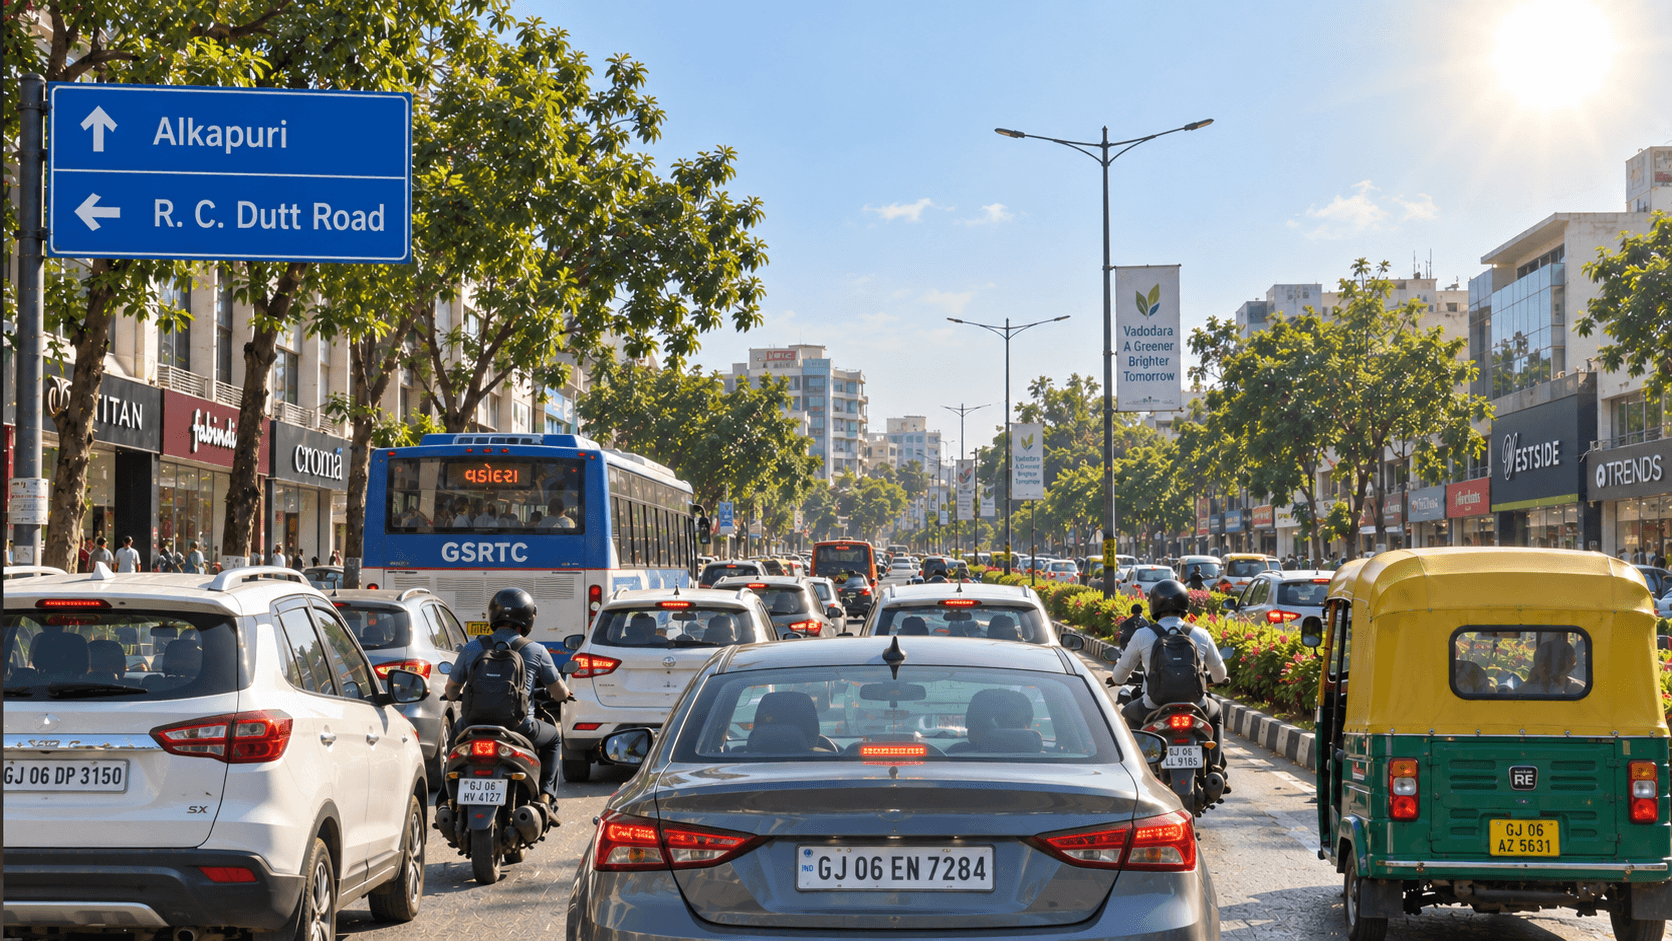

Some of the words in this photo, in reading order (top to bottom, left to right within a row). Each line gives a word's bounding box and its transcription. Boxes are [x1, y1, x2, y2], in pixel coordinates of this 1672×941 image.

[153, 116, 288, 155] Alkapuri
[154, 198, 183, 228] R.
[195, 199, 224, 228] C.
[237, 200, 302, 230] Dutt
[313, 202, 385, 232] Road
[1123, 324, 1174, 337] Vadodara
[1123, 341, 1132, 352] A
[1134, 340, 1175, 352] Greener
[1128, 355, 1170, 370] Brighter
[1123, 370, 1175, 382] Tomorrow
[192, 408, 238, 453] fabindi
[1501, 432, 1560, 481] WESTSIDE
[464, 462, 518, 483] વડોદરા
[1606, 454, 1663, 487] TRENDS
[441, 541, 529, 563] GSRTC
[4, 766, 25, 785] GJ
[29, 766, 50, 785] 06
[55, 767, 76, 785] DP
[80, 766, 123, 785] 3150
[1514, 774, 1534, 785] RE
[470, 781, 482, 790] GJ
[485, 782, 496, 790] 06
[464, 793, 476, 802] HV
[478, 793, 501, 802] 4127
[187, 805, 208, 814] SX
[1506, 823, 1523, 837] GJ
[1528, 823, 1544, 837] 06
[1498, 839, 1514, 853] AZ
[1519, 839, 1550, 853] 5631
[818, 856, 847, 881] GJ
[855, 856, 884, 881] 06
[891, 856, 920, 881] EN
[927, 856, 987, 881] 7284
